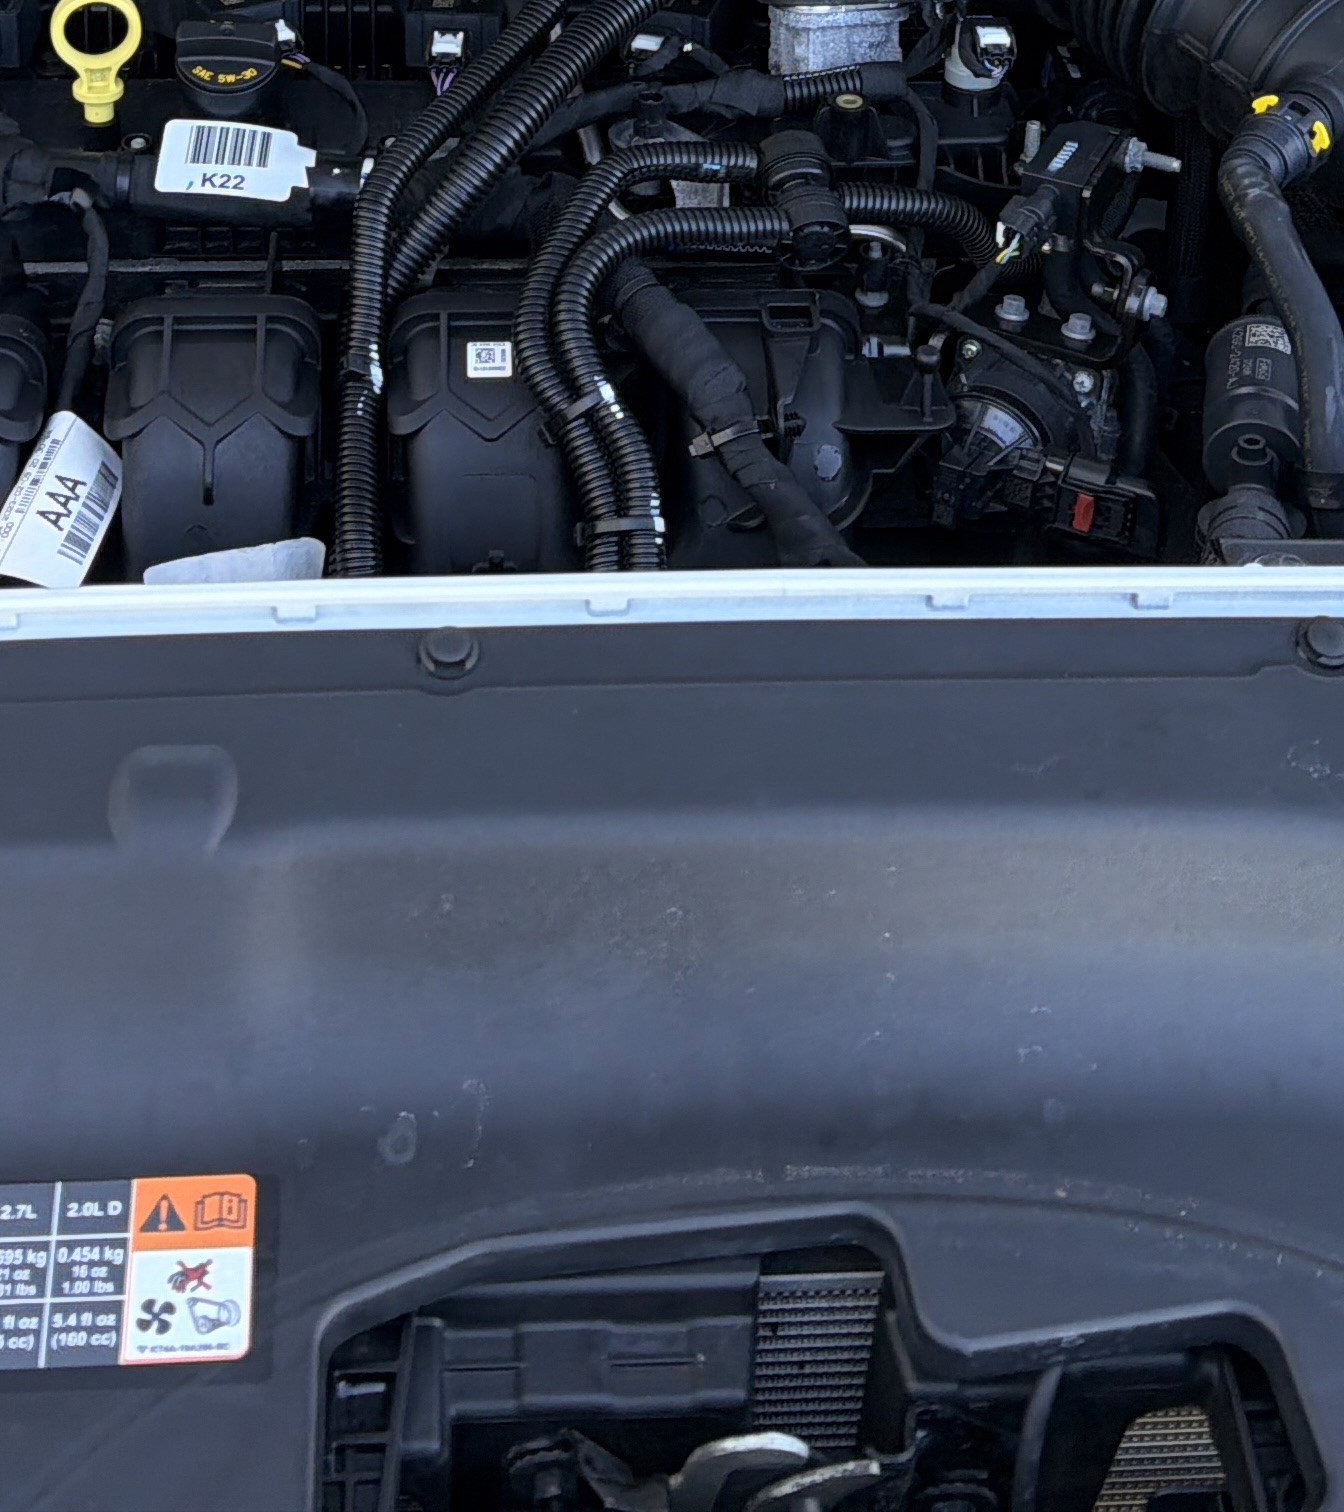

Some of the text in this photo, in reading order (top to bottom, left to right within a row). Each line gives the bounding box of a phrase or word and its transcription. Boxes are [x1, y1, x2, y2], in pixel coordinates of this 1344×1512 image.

[192, 65, 257, 83] SAE 5W-30
[200, 173, 246, 190] K22
[36, 474, 87, 532] AAA
[0, 1203, 38, 1220] 2.7L
[66, 1199, 123, 1218] 2.0L D
[27, 1248, 47, 1268] kg
[58, 1245, 124, 1265] 0.454 kg
[13, 1268, 31, 1281] oz
[91, 1266, 108, 1278] oz
[15, 1282, 37, 1297] lbs
[93, 1280, 115, 1294] lbs
[3, 1314, 16, 1330] fl
[18, 1316, 40, 1330] oz
[95, 1313, 117, 1327] oz
[7, 1332, 35, 1352] cc)
[90, 1330, 117, 1348] cc)
